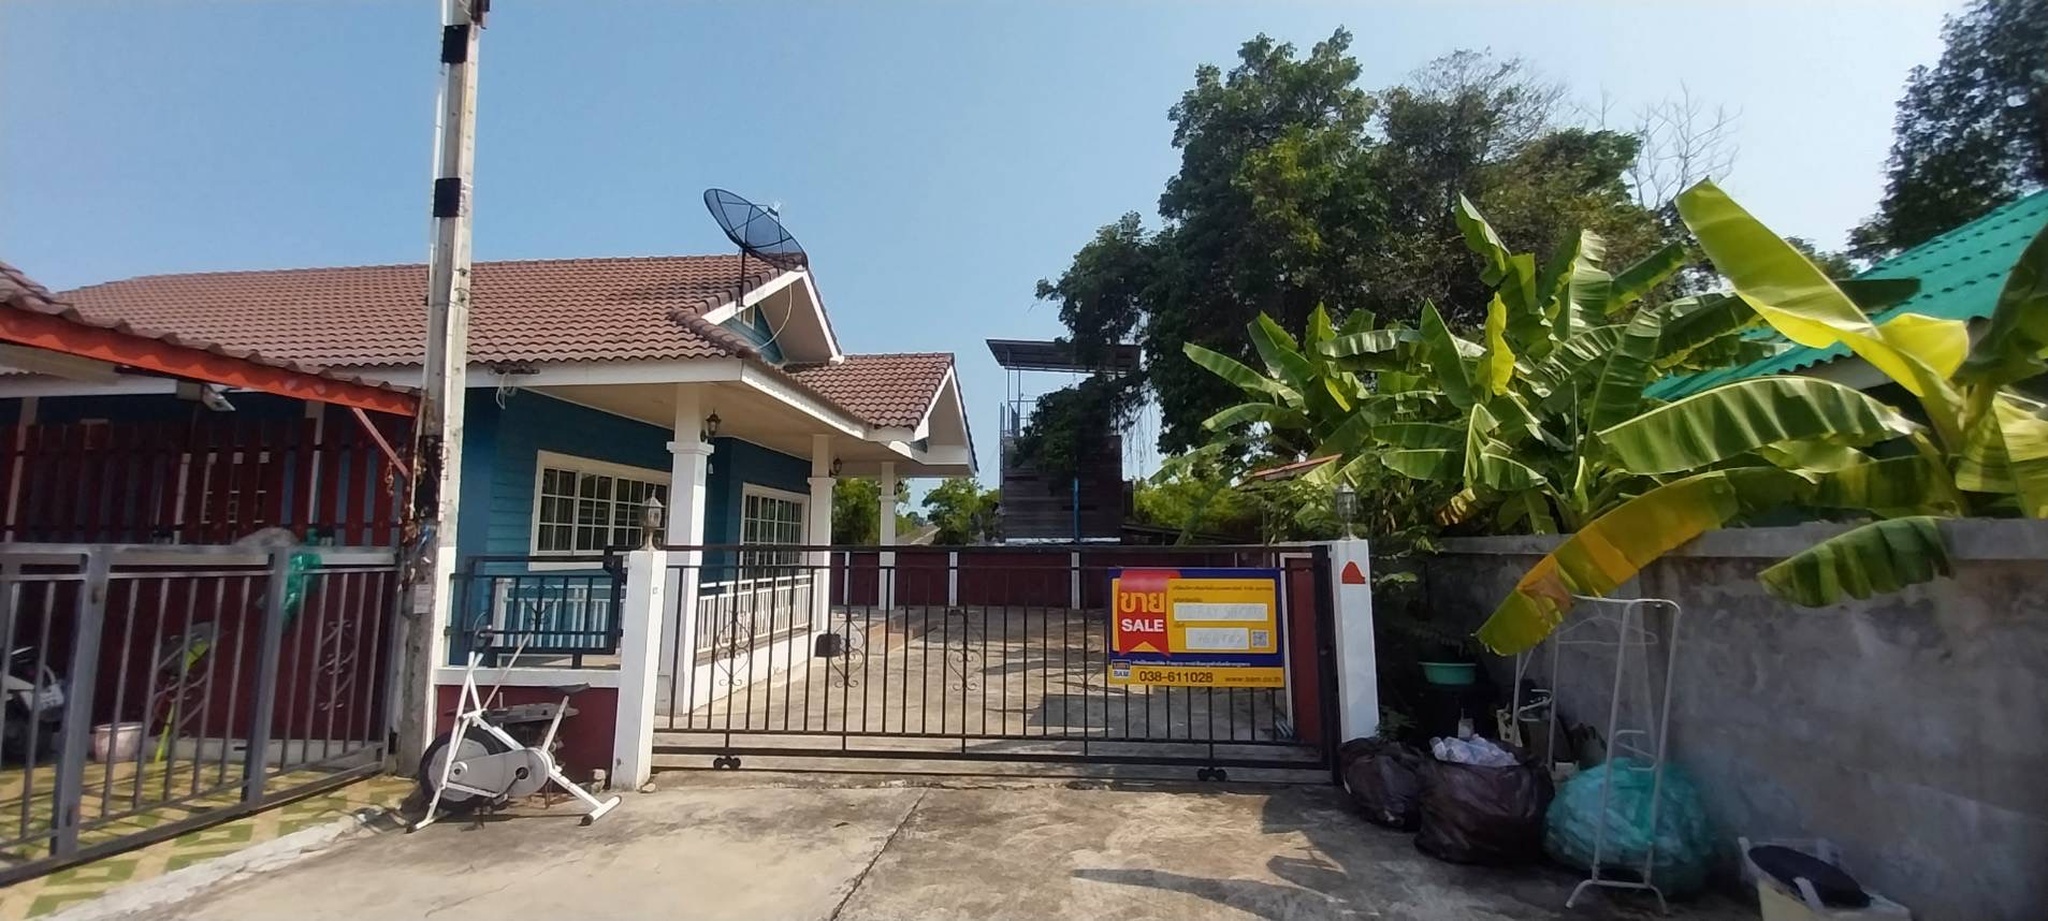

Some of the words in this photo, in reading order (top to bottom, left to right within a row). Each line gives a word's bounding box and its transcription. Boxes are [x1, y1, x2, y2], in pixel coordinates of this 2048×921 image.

[1120, 592, 1165, 613] ขาย
[1121, 618, 1164, 632] SALE
[1139, 670, 1214, 683] 038-611028
